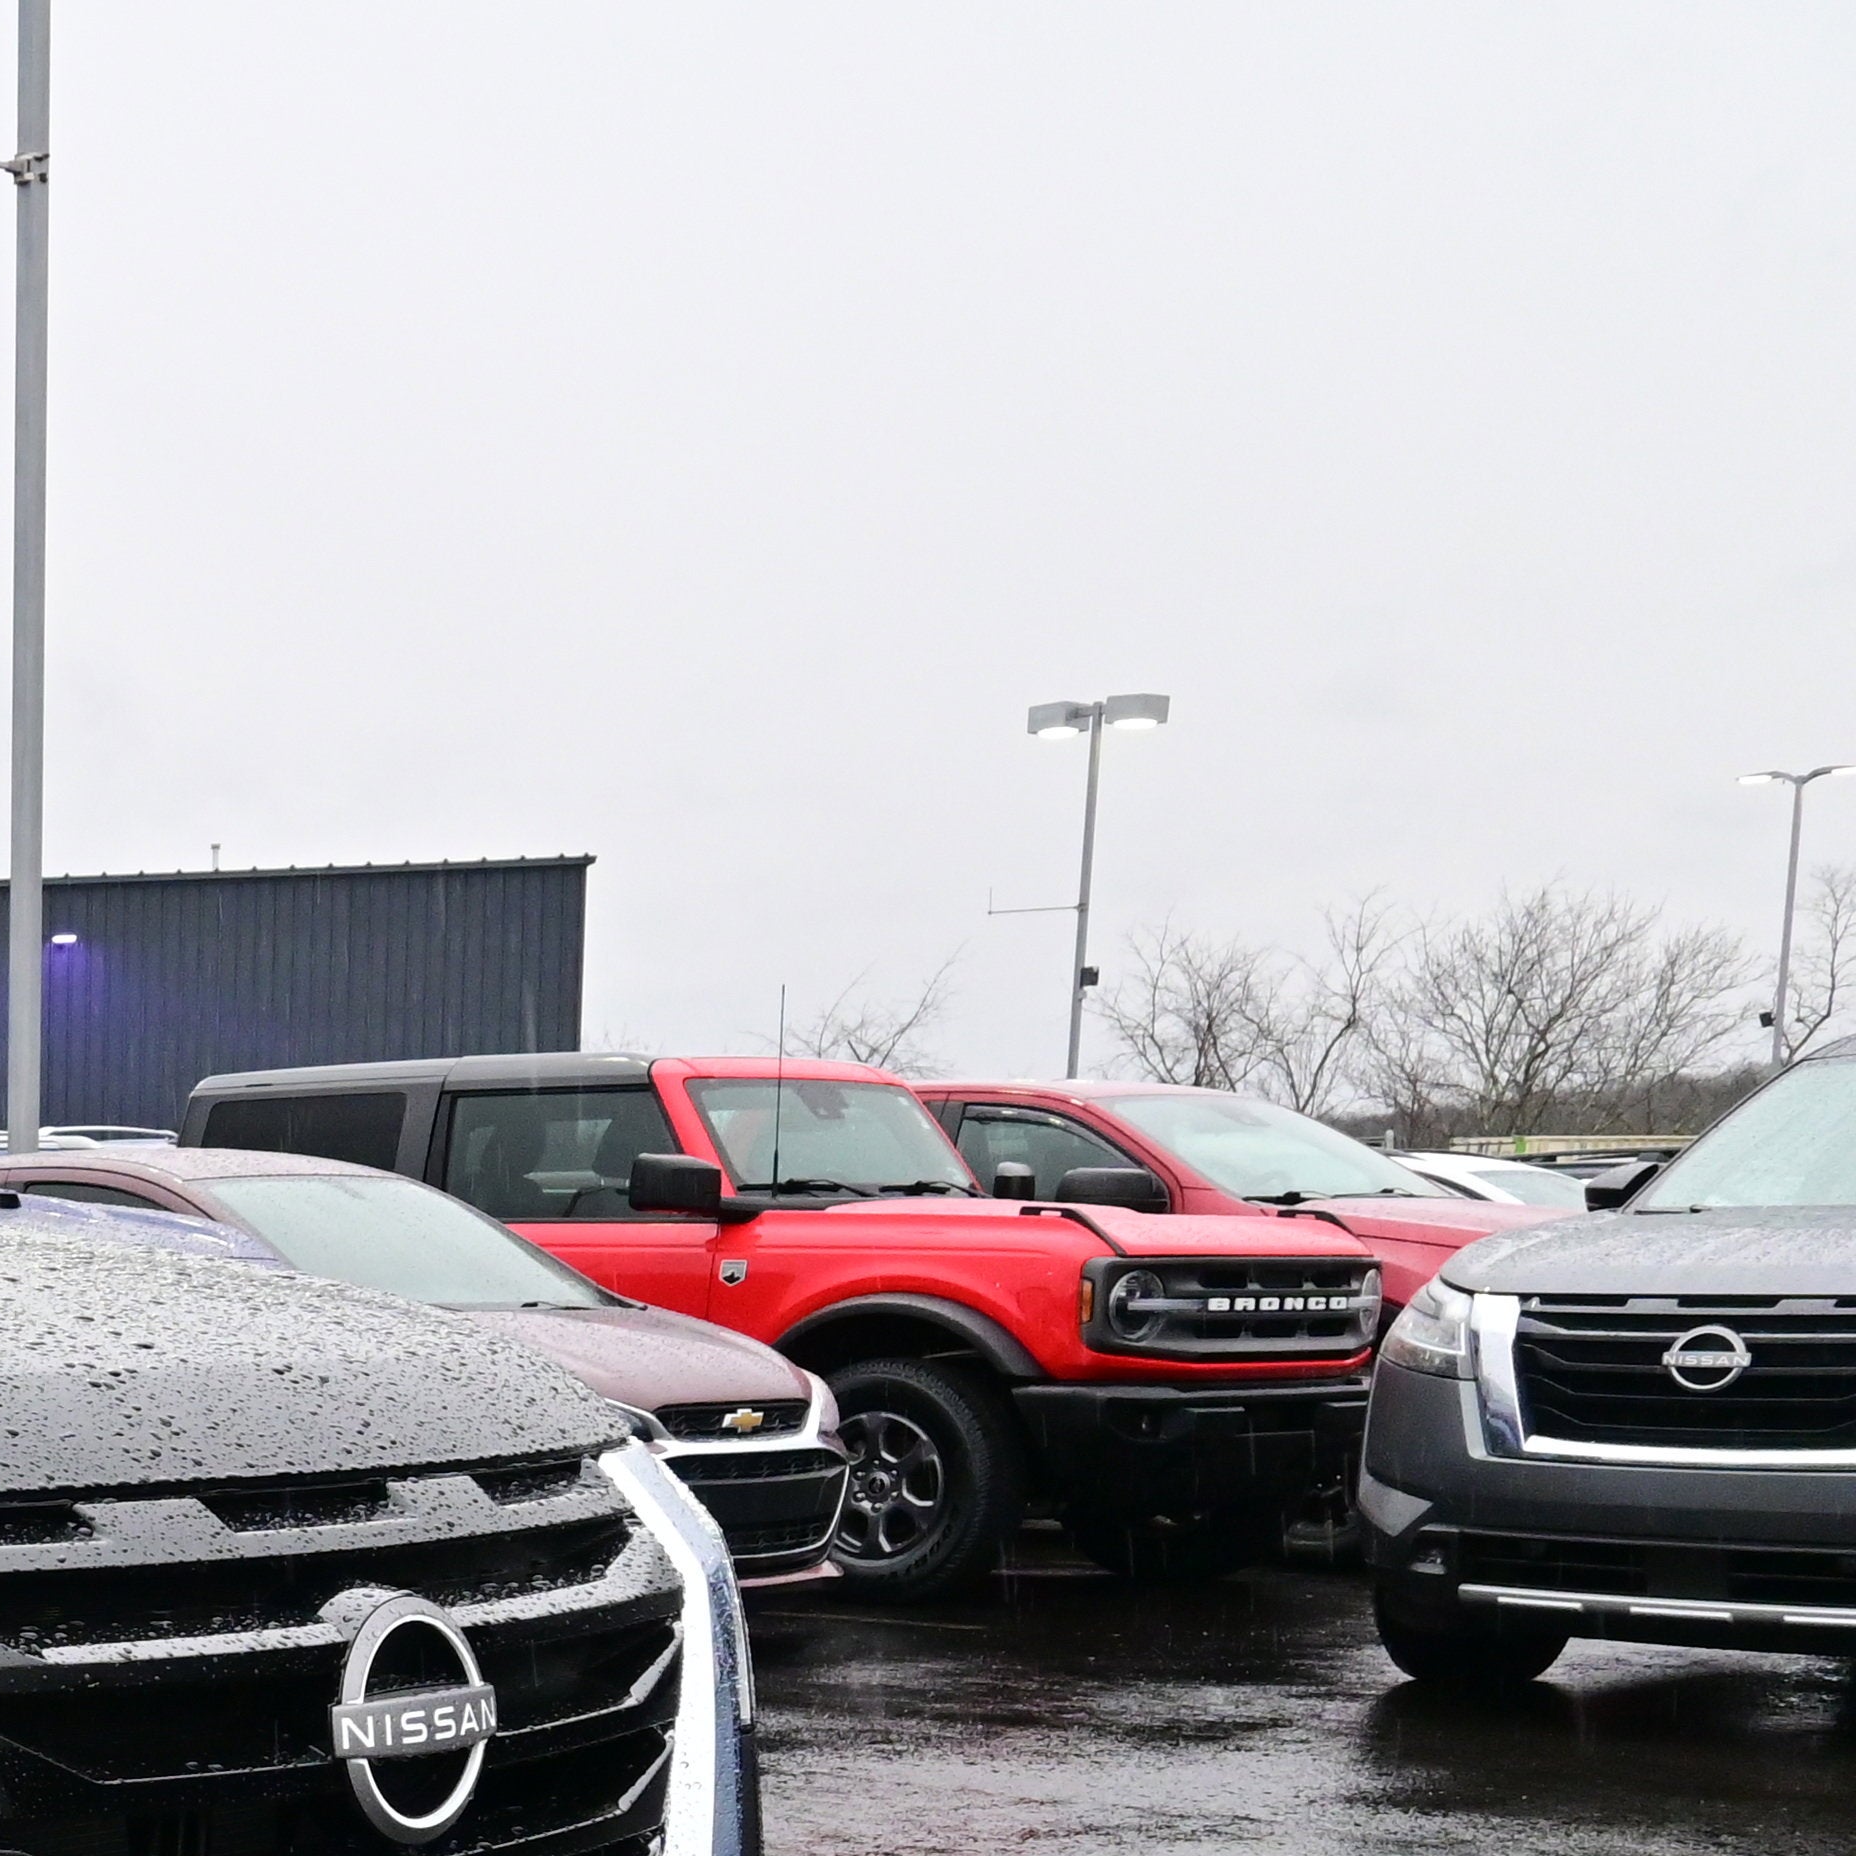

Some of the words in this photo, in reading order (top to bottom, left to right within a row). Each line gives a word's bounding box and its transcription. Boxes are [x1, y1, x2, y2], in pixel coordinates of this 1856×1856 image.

[1207, 1297, 1347, 1311] BRONCO
[1663, 1355, 1749, 1366] NISSAN
[341, 1696, 496, 1750] NISSAN
